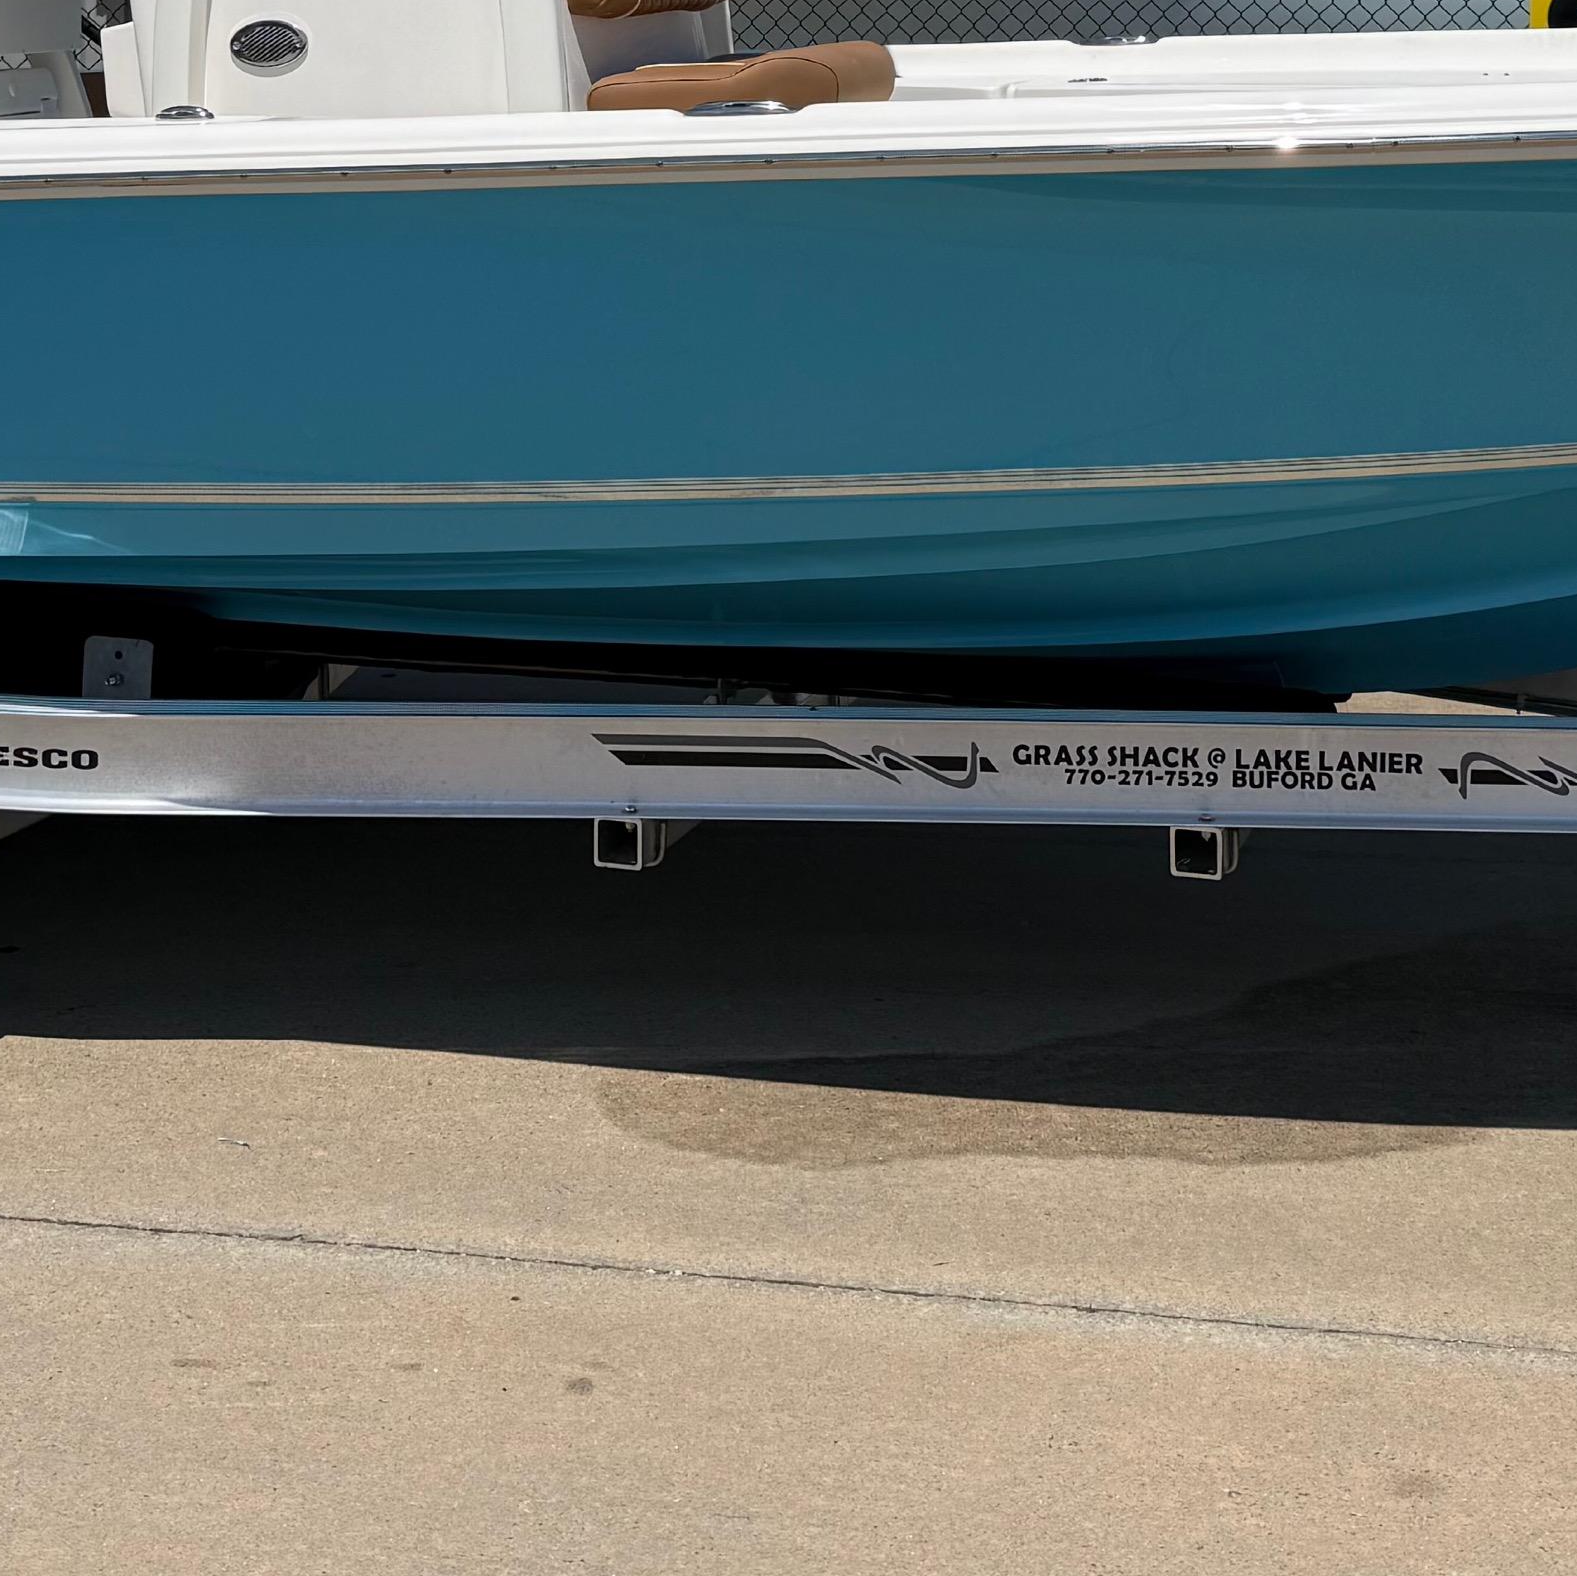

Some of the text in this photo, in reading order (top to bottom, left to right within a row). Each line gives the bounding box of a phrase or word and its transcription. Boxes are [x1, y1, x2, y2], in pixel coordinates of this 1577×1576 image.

[1012, 744, 1424, 775] GRASS SHACK @ LAKE LANIER
[1064, 768, 1376, 791] 770-271-7529 BUFORD GA
